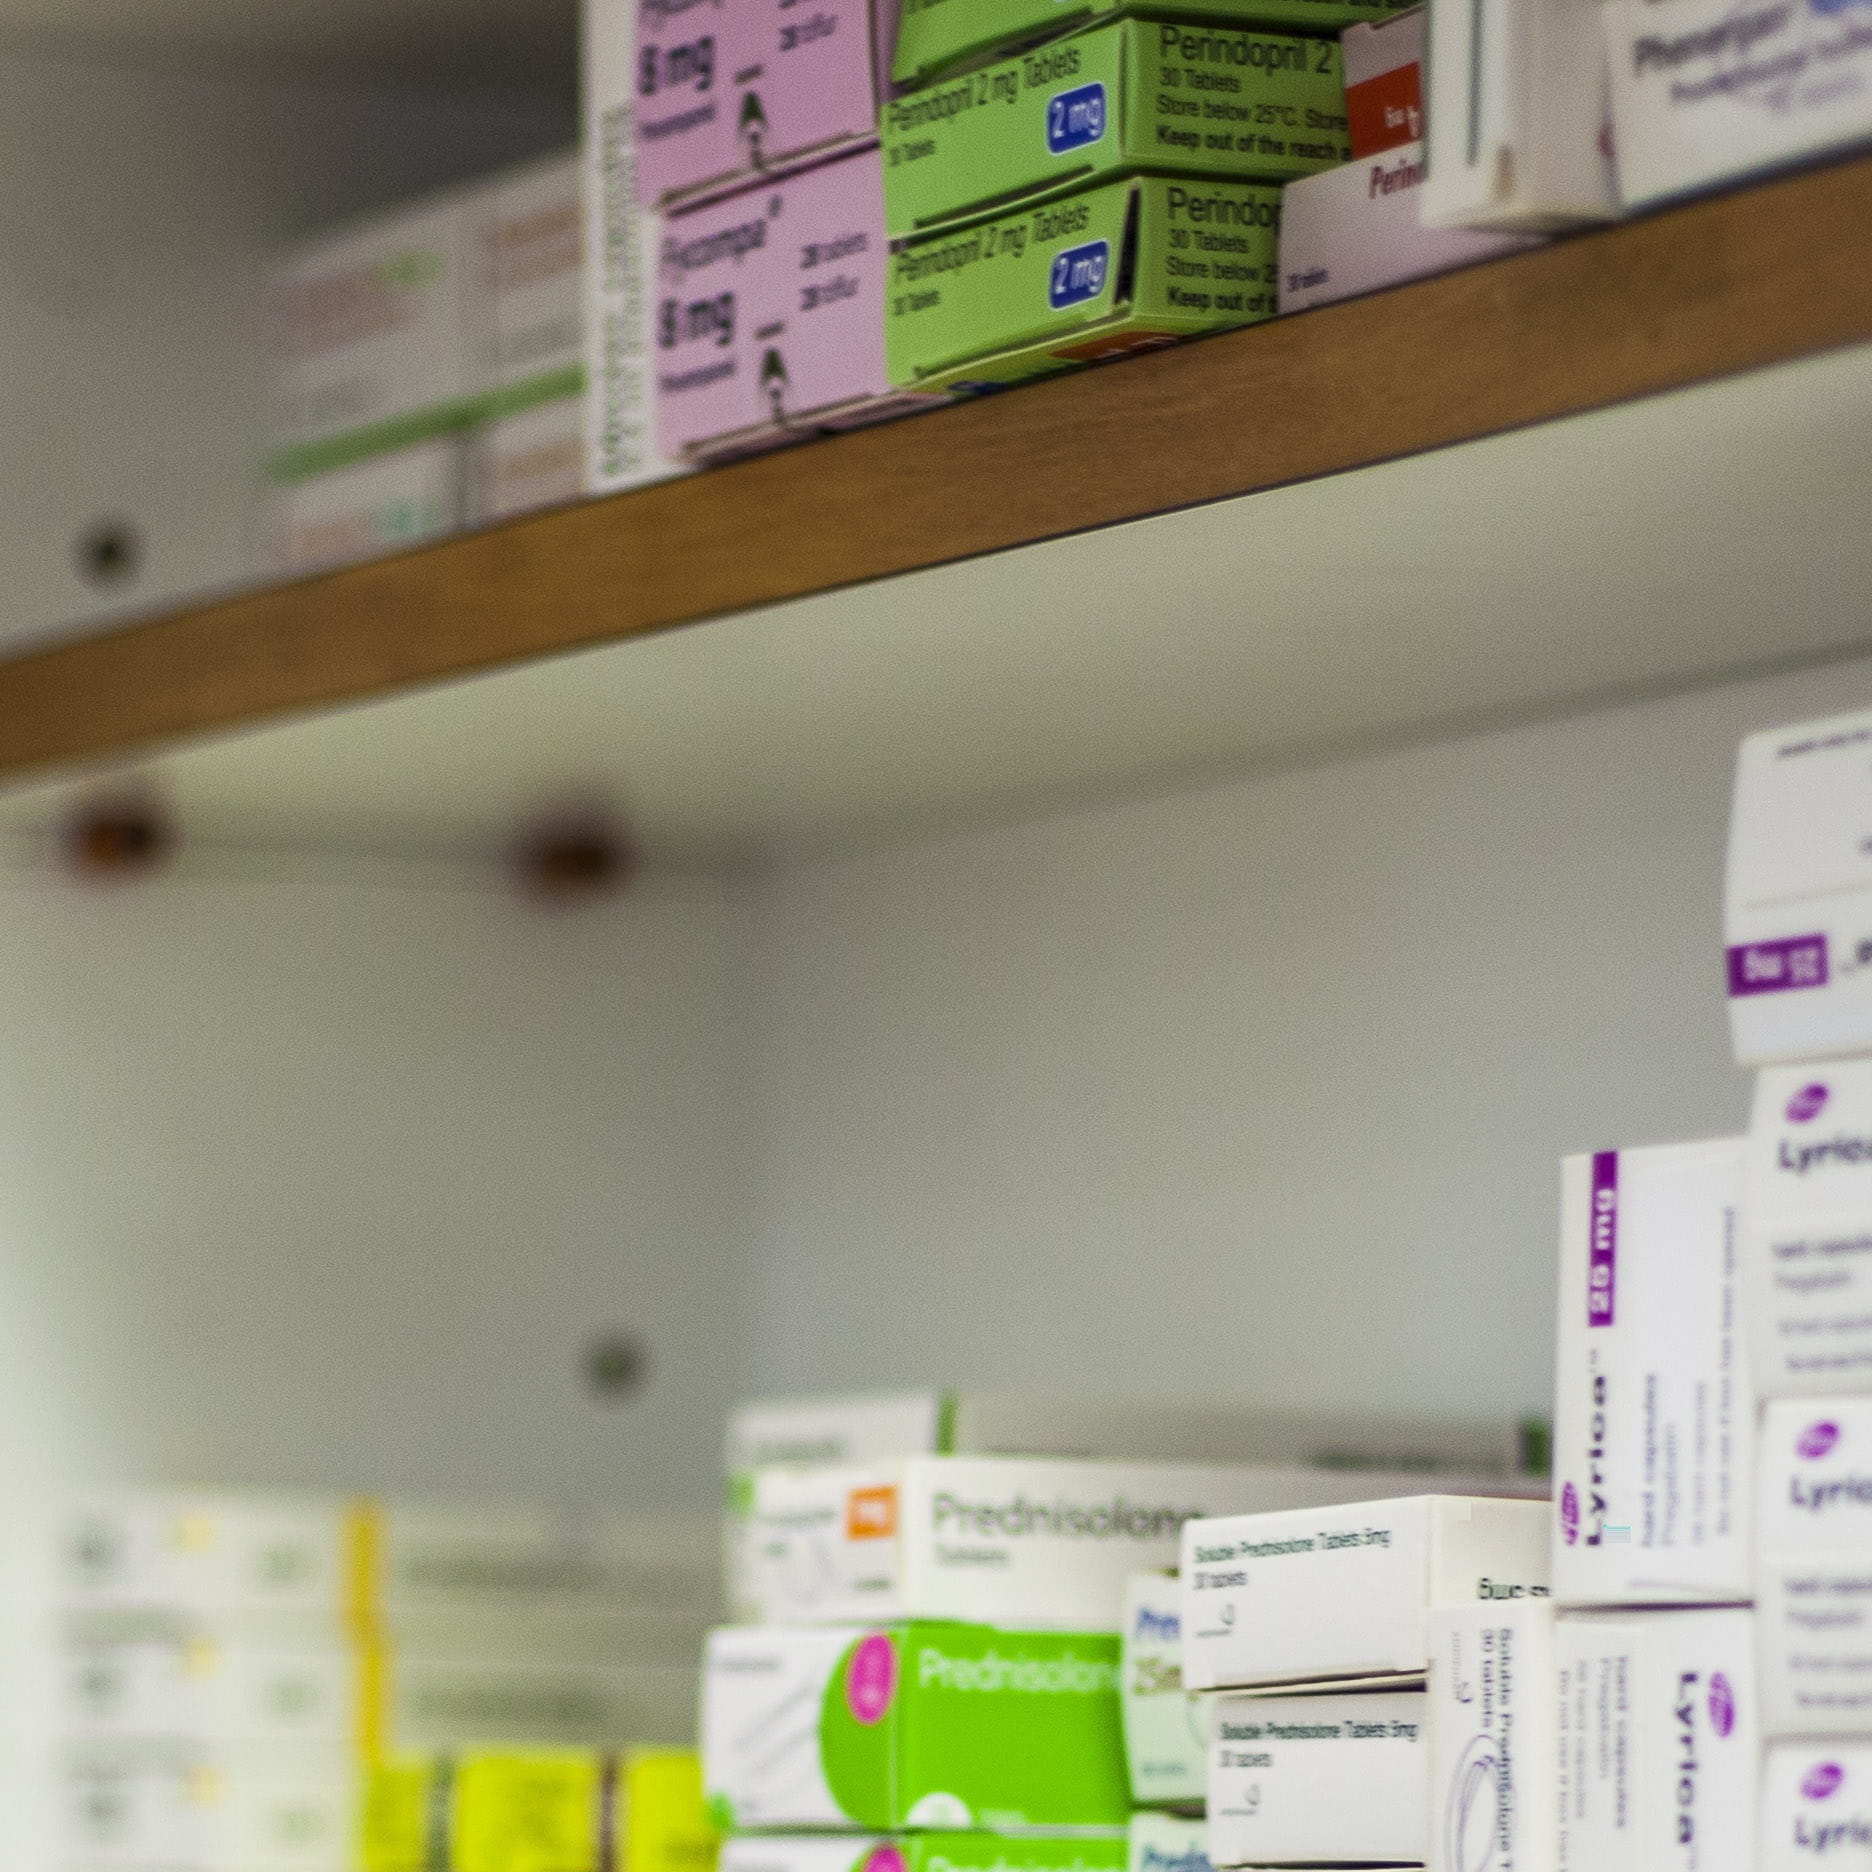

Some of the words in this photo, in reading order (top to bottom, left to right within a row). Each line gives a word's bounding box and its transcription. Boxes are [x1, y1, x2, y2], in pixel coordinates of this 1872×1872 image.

[668, 36, 715, 91] mg
[1024, 48, 1081, 88] Tablets
[1159, 25, 1308, 77] Perindopril
[1316, 41, 1332, 74] 2
[1160, 67, 1178, 87] 30
[1185, 69, 1241, 93] Tablets
[1053, 101, 1065, 139] 2
[1069, 98, 1100, 138] mg
[1157, 94, 1200, 118] Store
[1204, 99, 1251, 122] below
[1157, 125, 1200, 152] Keep
[1205, 133, 1233, 151] out
[1237, 135, 1256, 153] of
[1258, 135, 1285, 155] the
[1288, 140, 1334, 160] reach
[1033, 205, 1090, 243] Tablets
[1194, 230, 1249, 254] Tablets
[1054, 256, 1069, 295] 2
[1071, 255, 1105, 294] mg
[1166, 256, 1210, 280] Store
[1213, 256, 1261, 281] below
[688, 292, 735, 347] mg
[1167, 286, 1210, 312] Keep
[1216, 292, 1243, 311] out
[1594, 1188, 1616, 1251] mg
[1589, 1263, 1611, 1314] 25
[1585, 1375, 1607, 1548] Lyrica
[1496, 1628, 1513, 1706] Soluble
[1479, 1658, 1494, 1729] tablets
[1673, 1671, 1699, 1845] Lyrica
